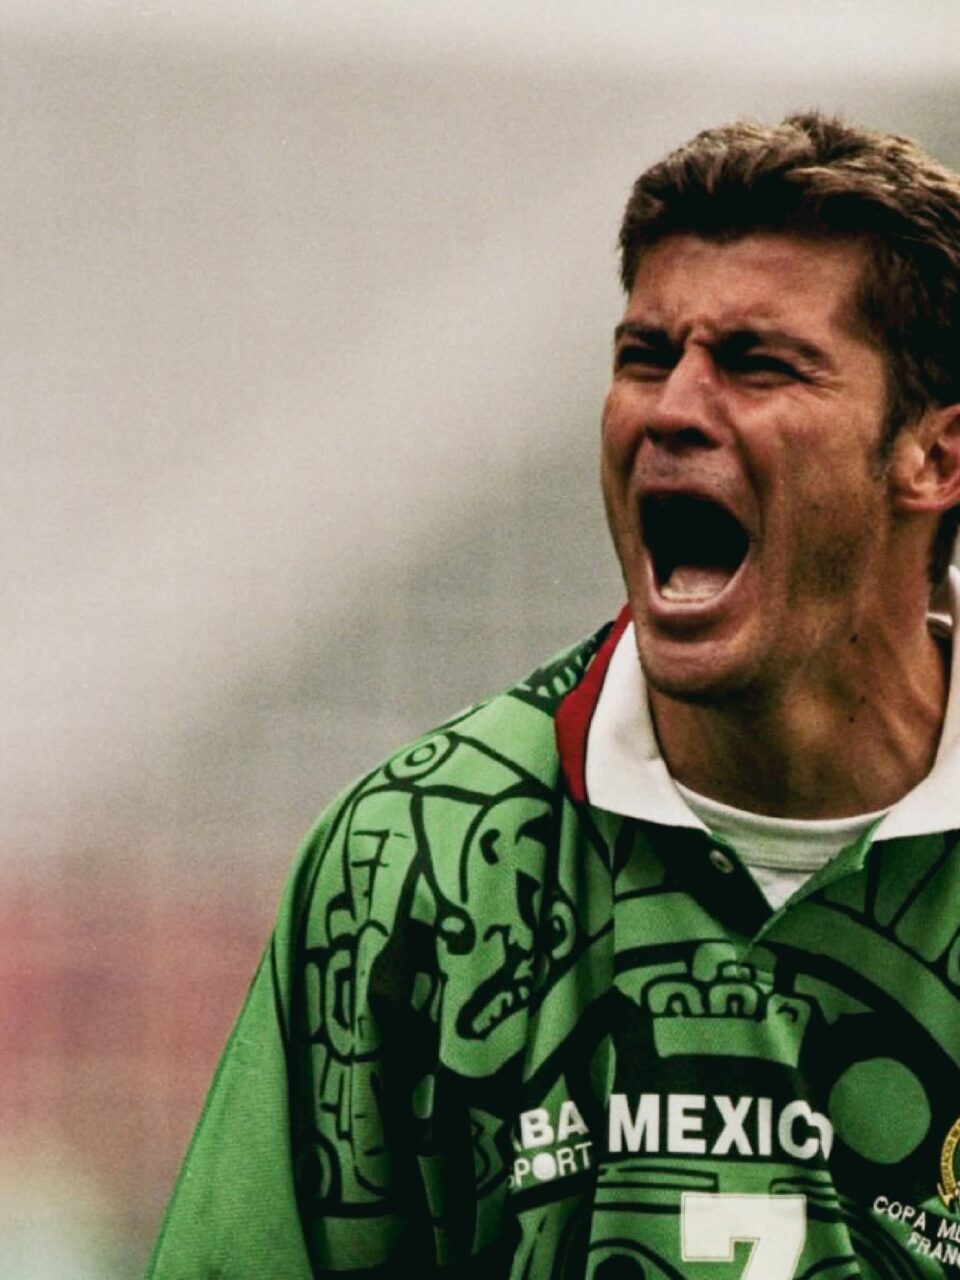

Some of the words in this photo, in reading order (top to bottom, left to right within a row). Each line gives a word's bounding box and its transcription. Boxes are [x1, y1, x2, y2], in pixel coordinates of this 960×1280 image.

[511, 1100, 589, 1151] BA
[508, 1142, 593, 1189] PORT
[873, 1196, 926, 1231] COPA
